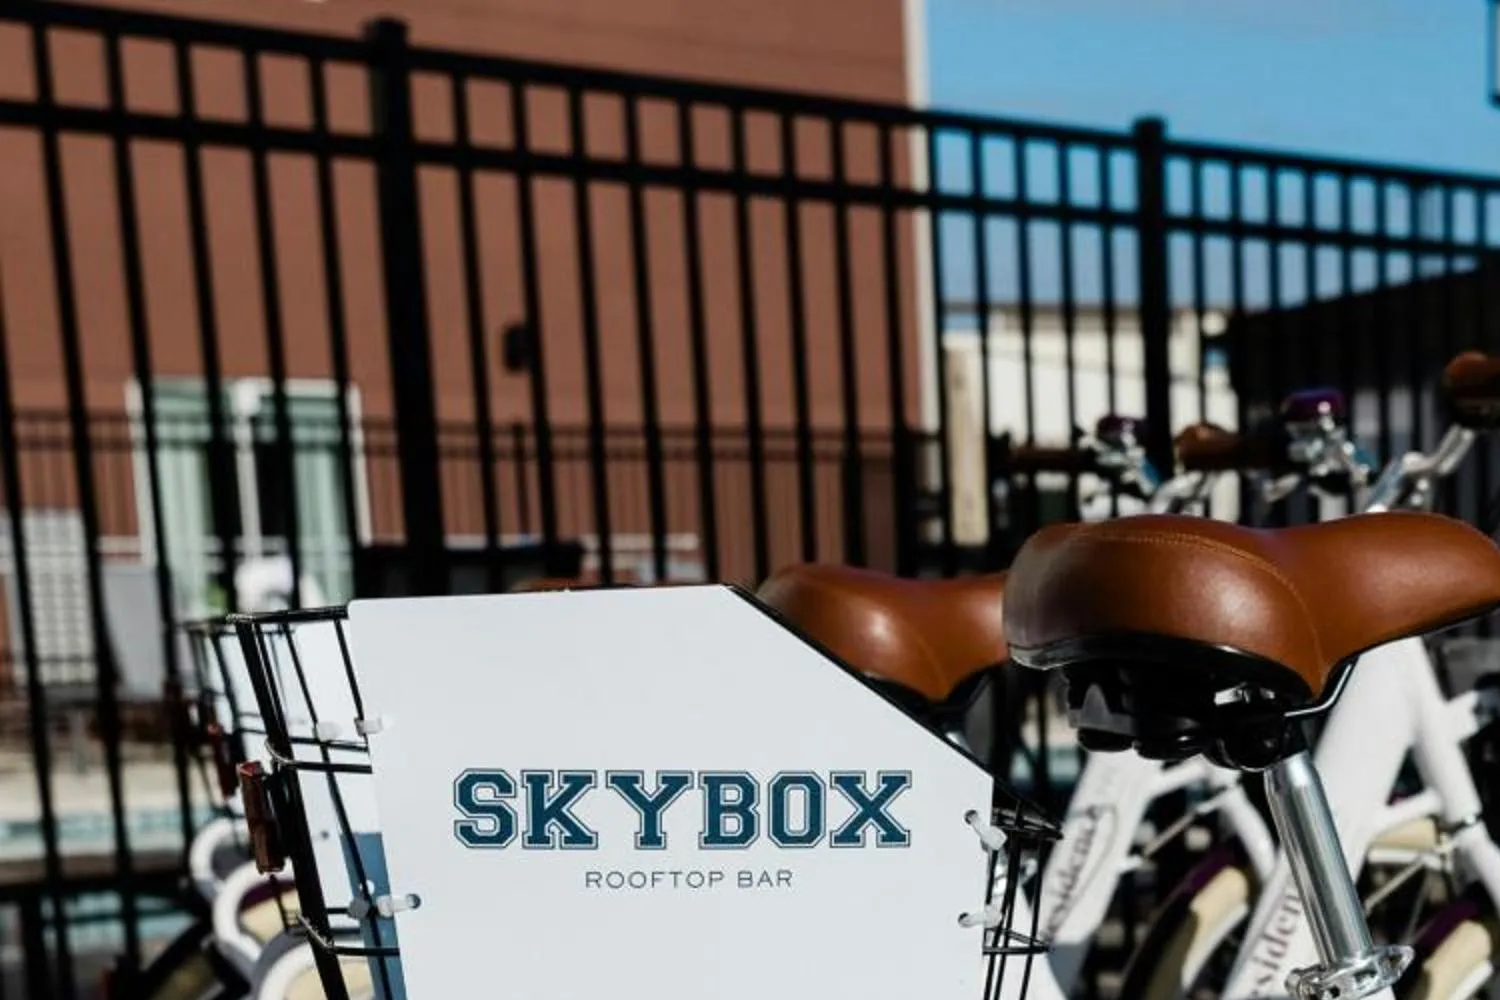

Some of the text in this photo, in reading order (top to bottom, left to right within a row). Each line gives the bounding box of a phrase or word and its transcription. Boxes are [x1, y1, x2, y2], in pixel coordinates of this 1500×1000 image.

[453, 768, 912, 850] SKYBOX
[585, 869, 793, 889] ROOFTOP BAR
